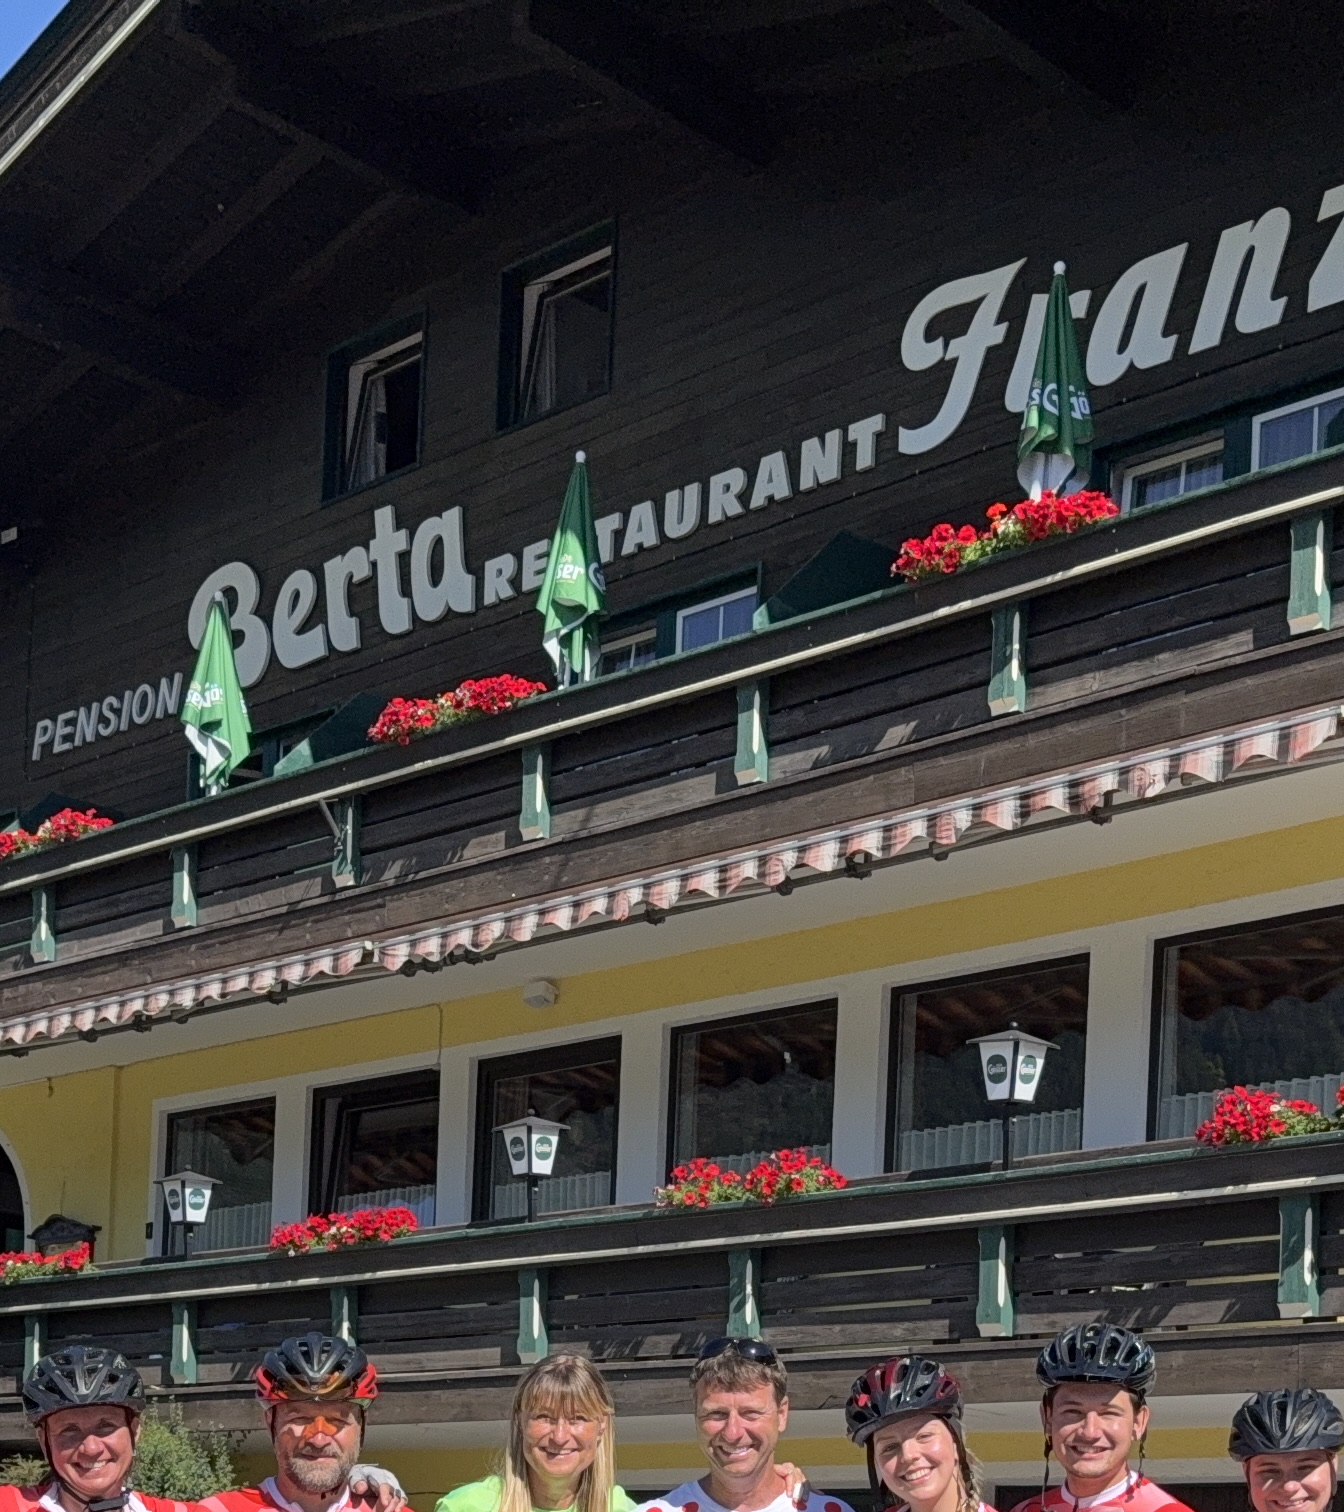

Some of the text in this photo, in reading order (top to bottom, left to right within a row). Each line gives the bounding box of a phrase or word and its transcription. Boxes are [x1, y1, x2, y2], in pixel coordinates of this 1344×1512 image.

[31, 671, 184, 761] PENSION
[187, 504, 476, 689] Berta
[484, 413, 886, 606] RETAURANT
